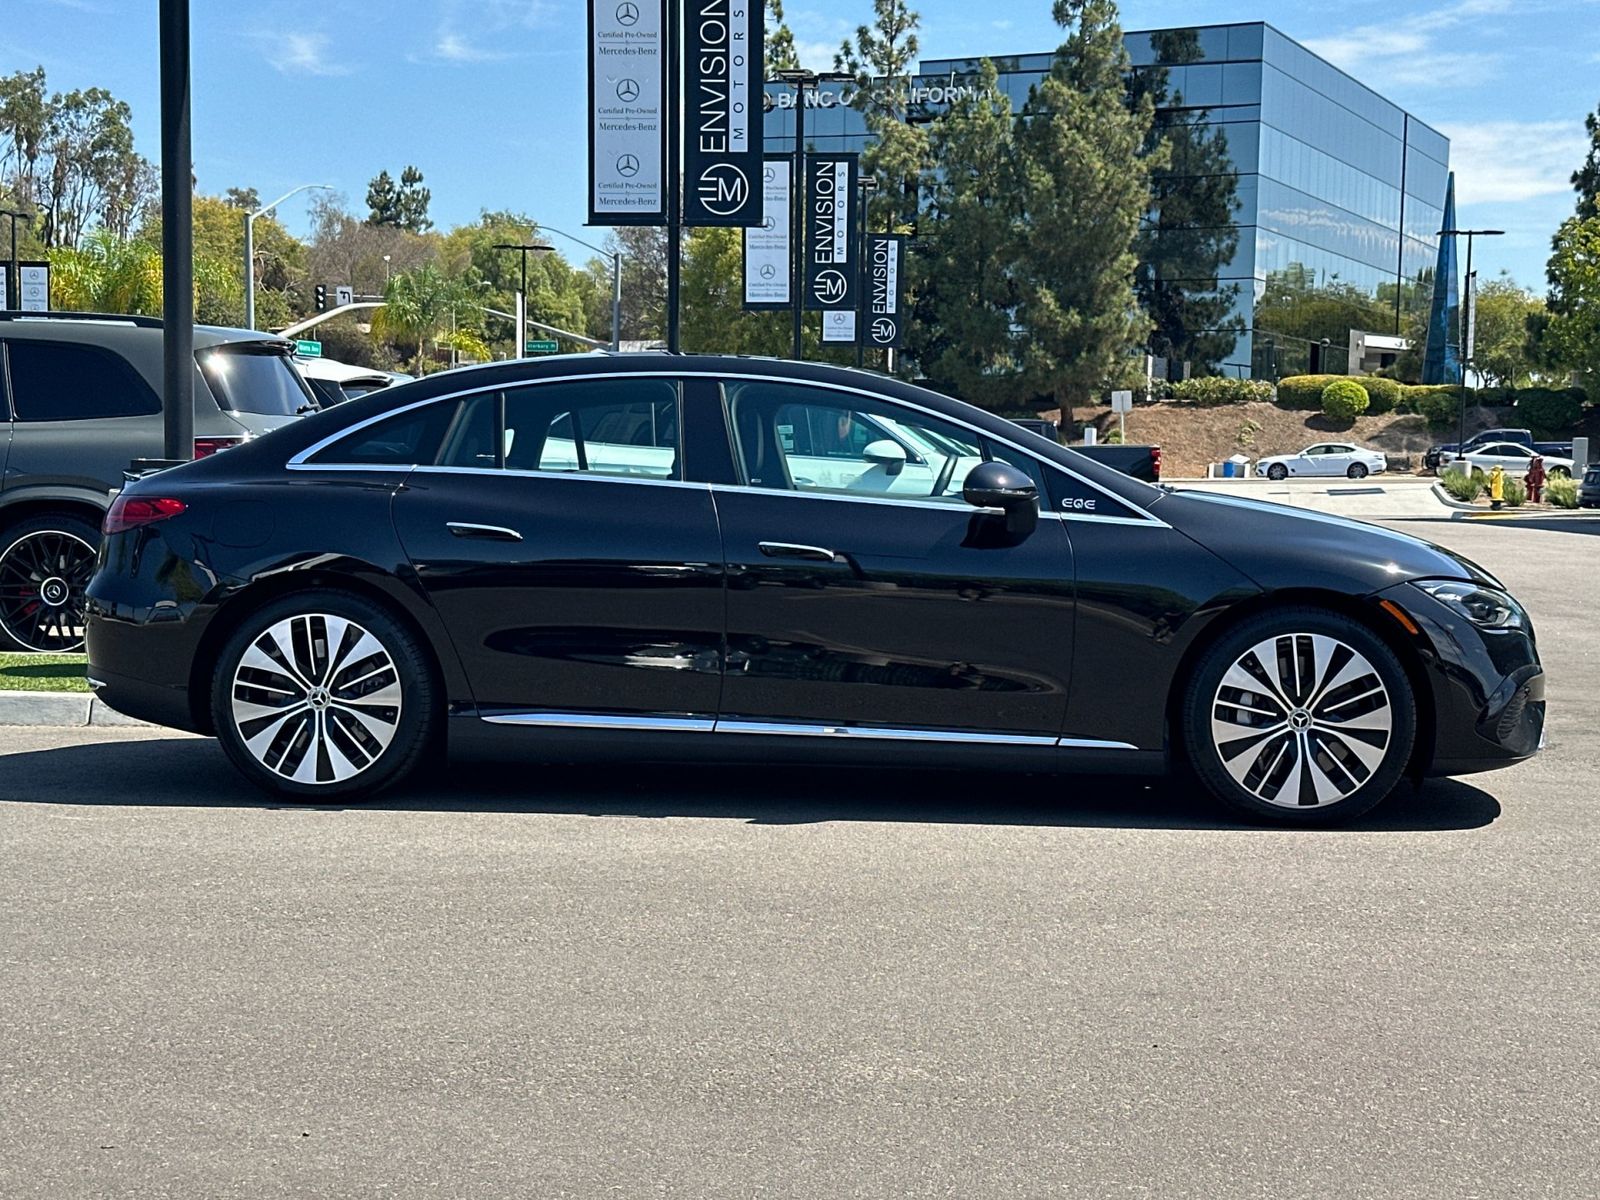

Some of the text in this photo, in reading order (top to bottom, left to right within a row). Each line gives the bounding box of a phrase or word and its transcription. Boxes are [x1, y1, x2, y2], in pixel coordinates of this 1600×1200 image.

[599, 46, 657, 55] Mercedes-Benz
[700, 0, 726, 153] ENVISION
[733, 9, 744, 140] MOTORS
[599, 122, 657, 131] Mercedes-Benz
[599, 197, 657, 206] Mercedes-Benz
[815, 161, 834, 263] ENVISION
[836, 171, 846, 255] MOTORS
[873, 239, 888, 314] ENVISION
[1061, 497, 1096, 510] EQE
